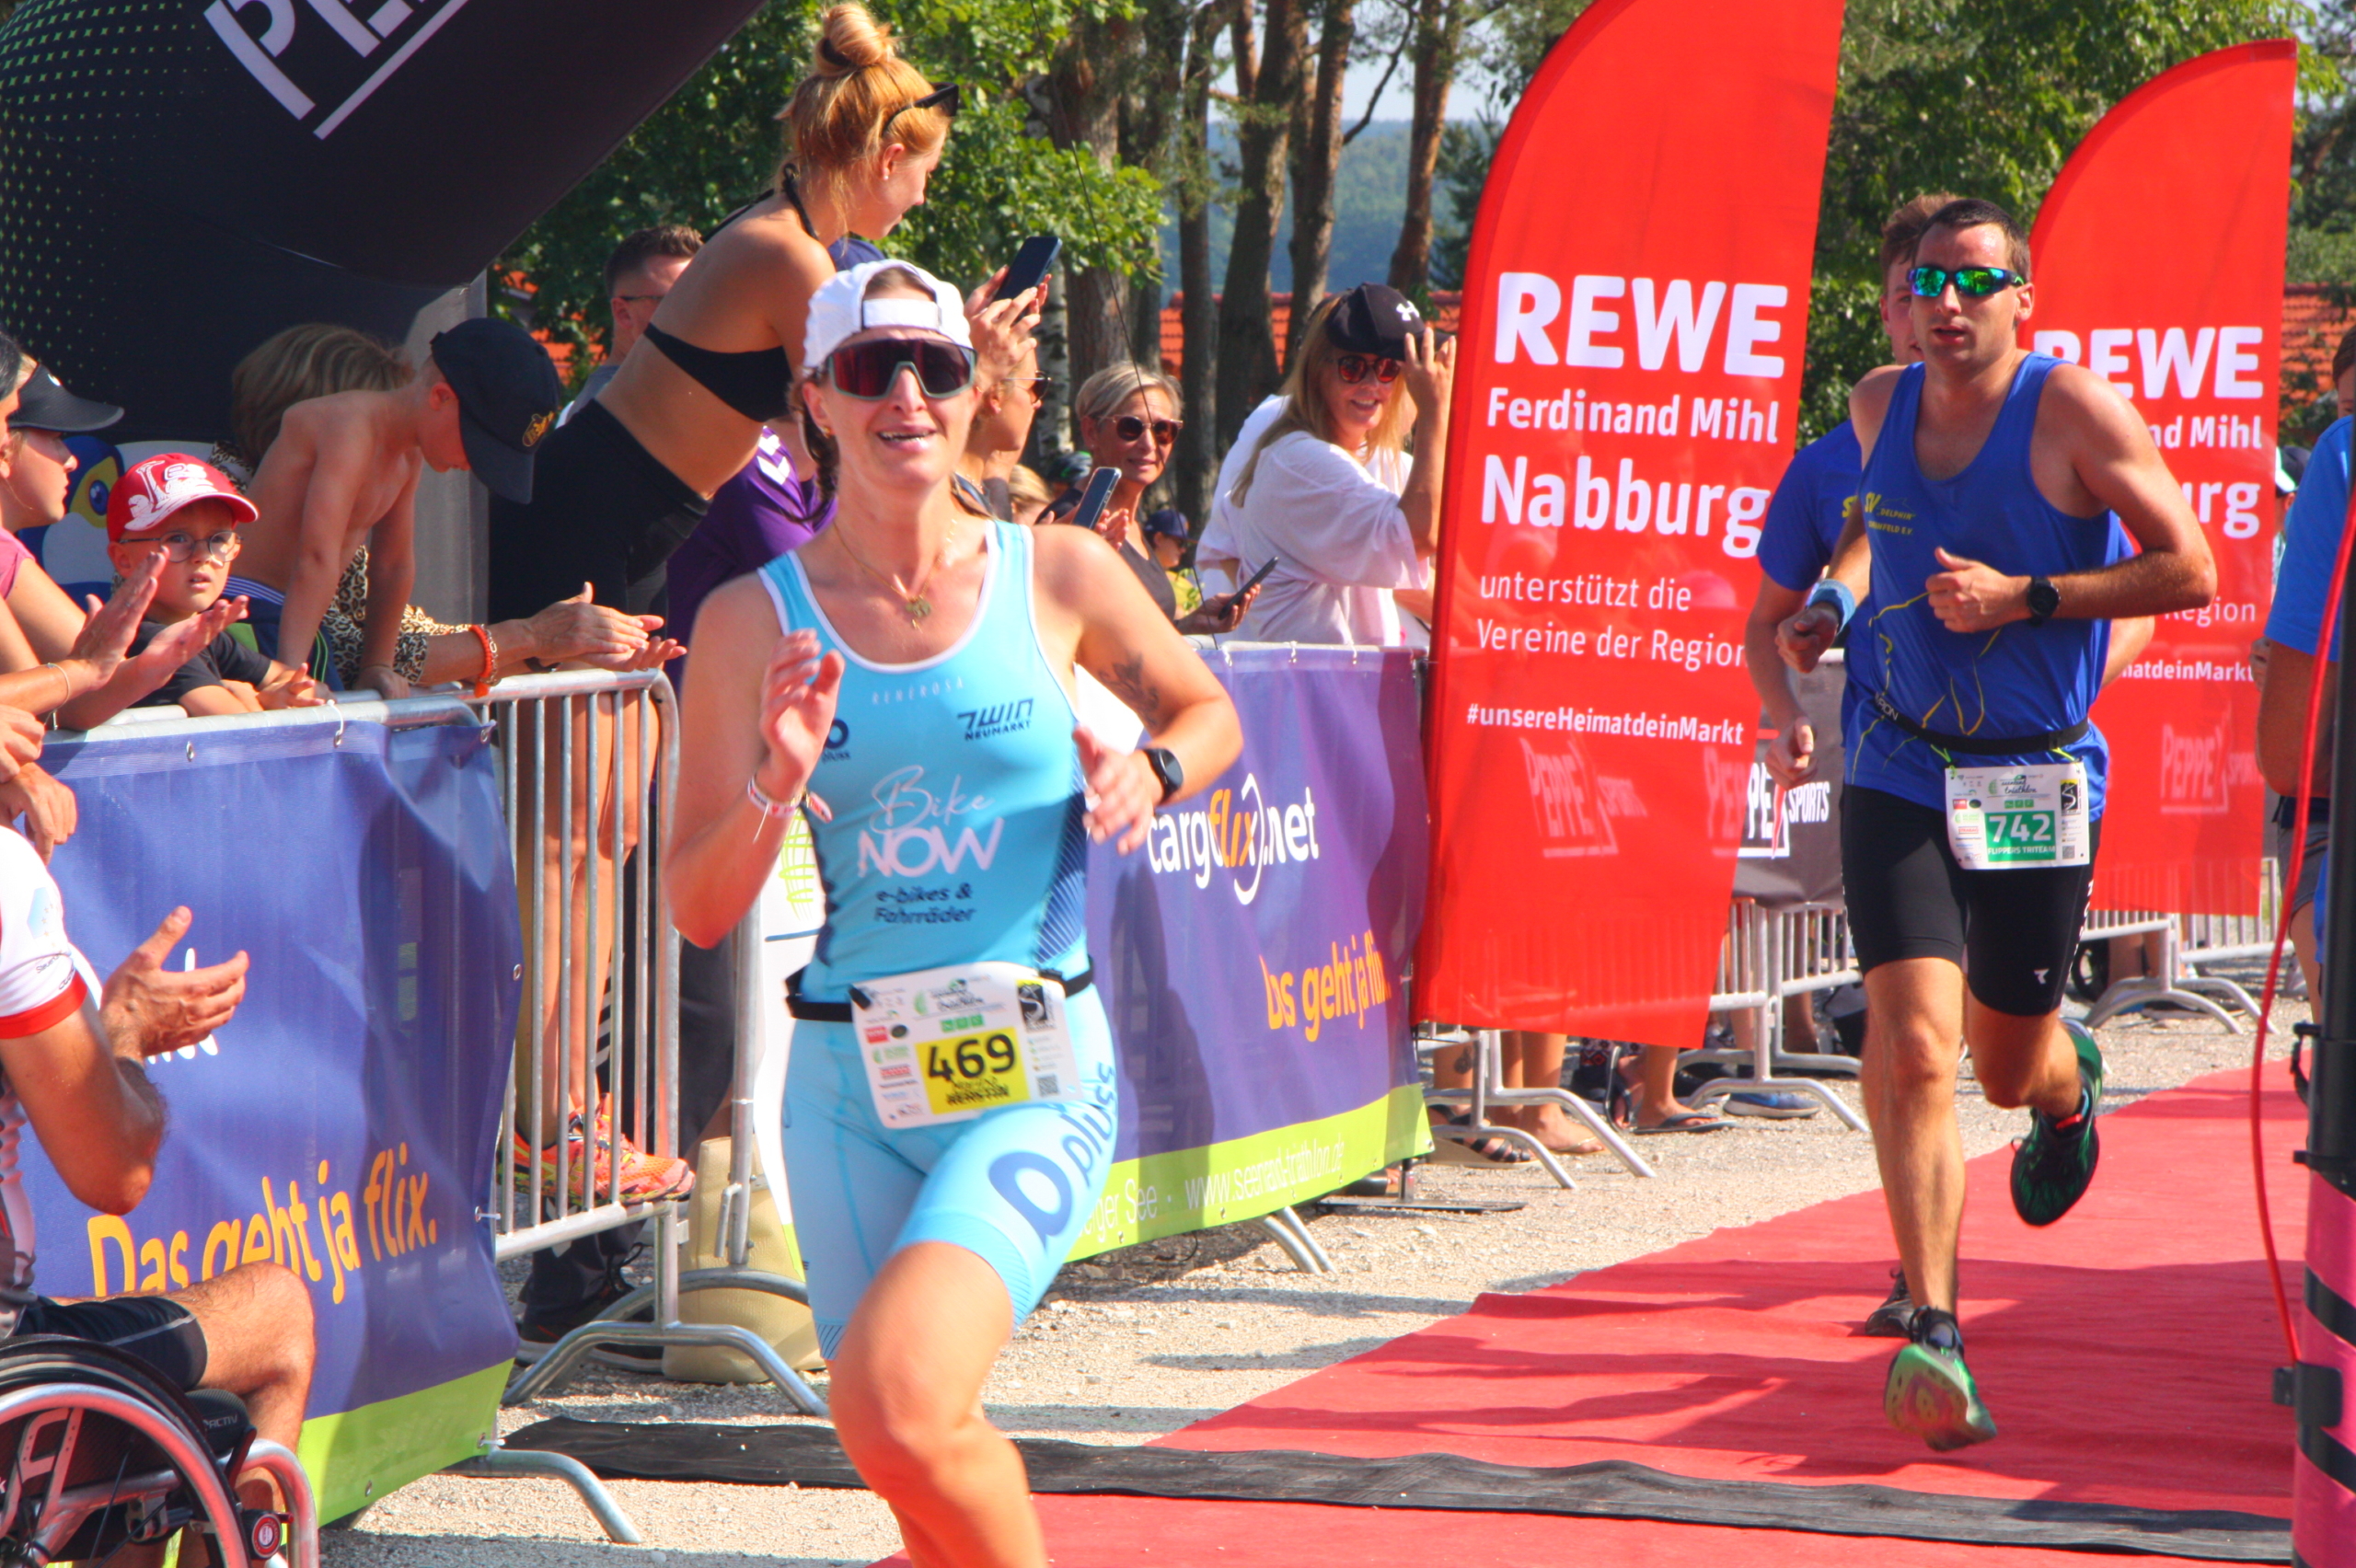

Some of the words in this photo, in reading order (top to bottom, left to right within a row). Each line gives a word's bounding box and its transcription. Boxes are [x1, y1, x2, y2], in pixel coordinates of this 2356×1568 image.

[1495, 272, 1787, 377] REWE
[1487, 387, 1680, 437] Ferdinand
[1692, 398, 1778, 444] Mihl
[2189, 415, 2261, 449] Mihl
[1482, 455, 1771, 558] Nabburg
[1481, 572, 1638, 608] unterstützt
[1648, 577, 1692, 611] die
[1477, 618, 1586, 654] Vereine
[1596, 626, 1641, 660] der
[1467, 704, 1744, 744] #unsereHeimatdeinMarkt
[870, 765, 995, 835] Bike
[1788, 780, 1831, 823] SPORTS
[858, 817, 1004, 878] NOW
[1989, 813, 2051, 843] 742
[2022, 844, 2056, 855] TRITEAM
[876, 885, 950, 903] e-bikes
[955, 882, 974, 900] &
[875, 905, 976, 925] Fahrräder
[1302, 941, 1356, 1042] geht
[928, 1033, 1017, 1080] 469
[87, 1214, 191, 1297] Das
[202, 1176, 324, 1282] geht
[318, 1159, 362, 1304] ja
[364, 1142, 437, 1262] flix.
[1125, 1179, 1157, 1224] See
